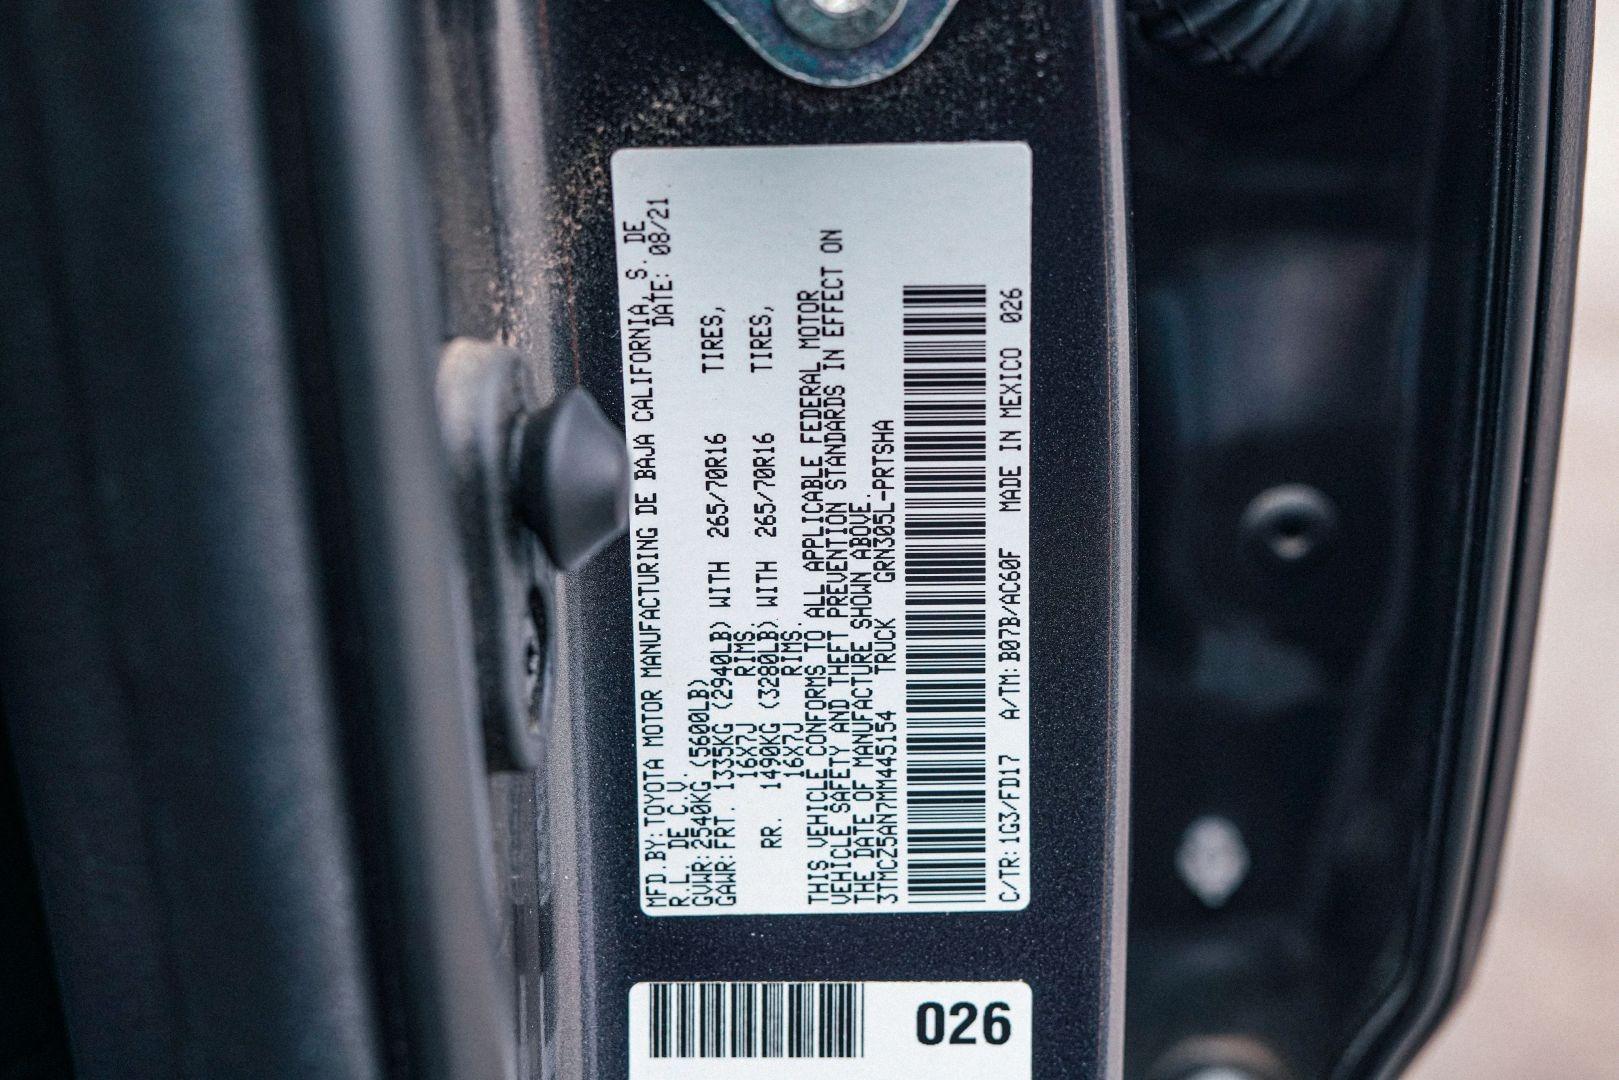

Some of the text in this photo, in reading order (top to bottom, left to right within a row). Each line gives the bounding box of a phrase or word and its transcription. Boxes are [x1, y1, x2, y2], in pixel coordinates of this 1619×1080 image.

[623, 221, 646, 243] DE
[626, 260, 647, 279] S.
[647, 198, 674, 326] DATE: 08/21
[700, 307, 725, 373] TIRES,
[1000, 288, 1022, 324] 026
[628, 296, 653, 422] CALIFORNIA,
[999, 348, 1022, 418] MEXICO
[633, 434, 656, 480] BAJA
[999, 431, 1022, 451] IN
[635, 493, 657, 515] DE
[704, 433, 729, 538] 265/70R16
[999, 466, 1022, 512] MADE
[636, 528, 661, 677] MANUFACTURING
[708, 562, 730, 607] WITH
[749, 306, 782, 848] RR. 1490KG (3280LB) WITH 265/70R16 TIRES,
[797, 290, 829, 904] THIS VEHICLE CONFORMS TO ALL APPLICABLE FEDERAL MOTOR
[820, 229, 851, 904] VEHICLE SAFETY AND THEFT PREVENTION STANDARDS IN EFFECT ON
[709, 621, 733, 709] (2940LB)
[733, 623, 757, 778] 16X7J RIMS.
[781, 623, 804, 778] 16X7J RIMS.
[849, 494, 874, 904] THE DATE OF MANUFACTURE SHOWN ABOVE.
[872, 420, 898, 904] 3TMCZ5AN7MM445154 TRUCK GRN305L-PRTSHA
[641, 690, 663, 746] MOTOR
[687, 679, 710, 767] (5600LB)
[712, 723, 735, 790] 1335KG
[667, 773, 690, 907] R.L. DE C.V.
[915, 1001, 1012, 1046] 026
